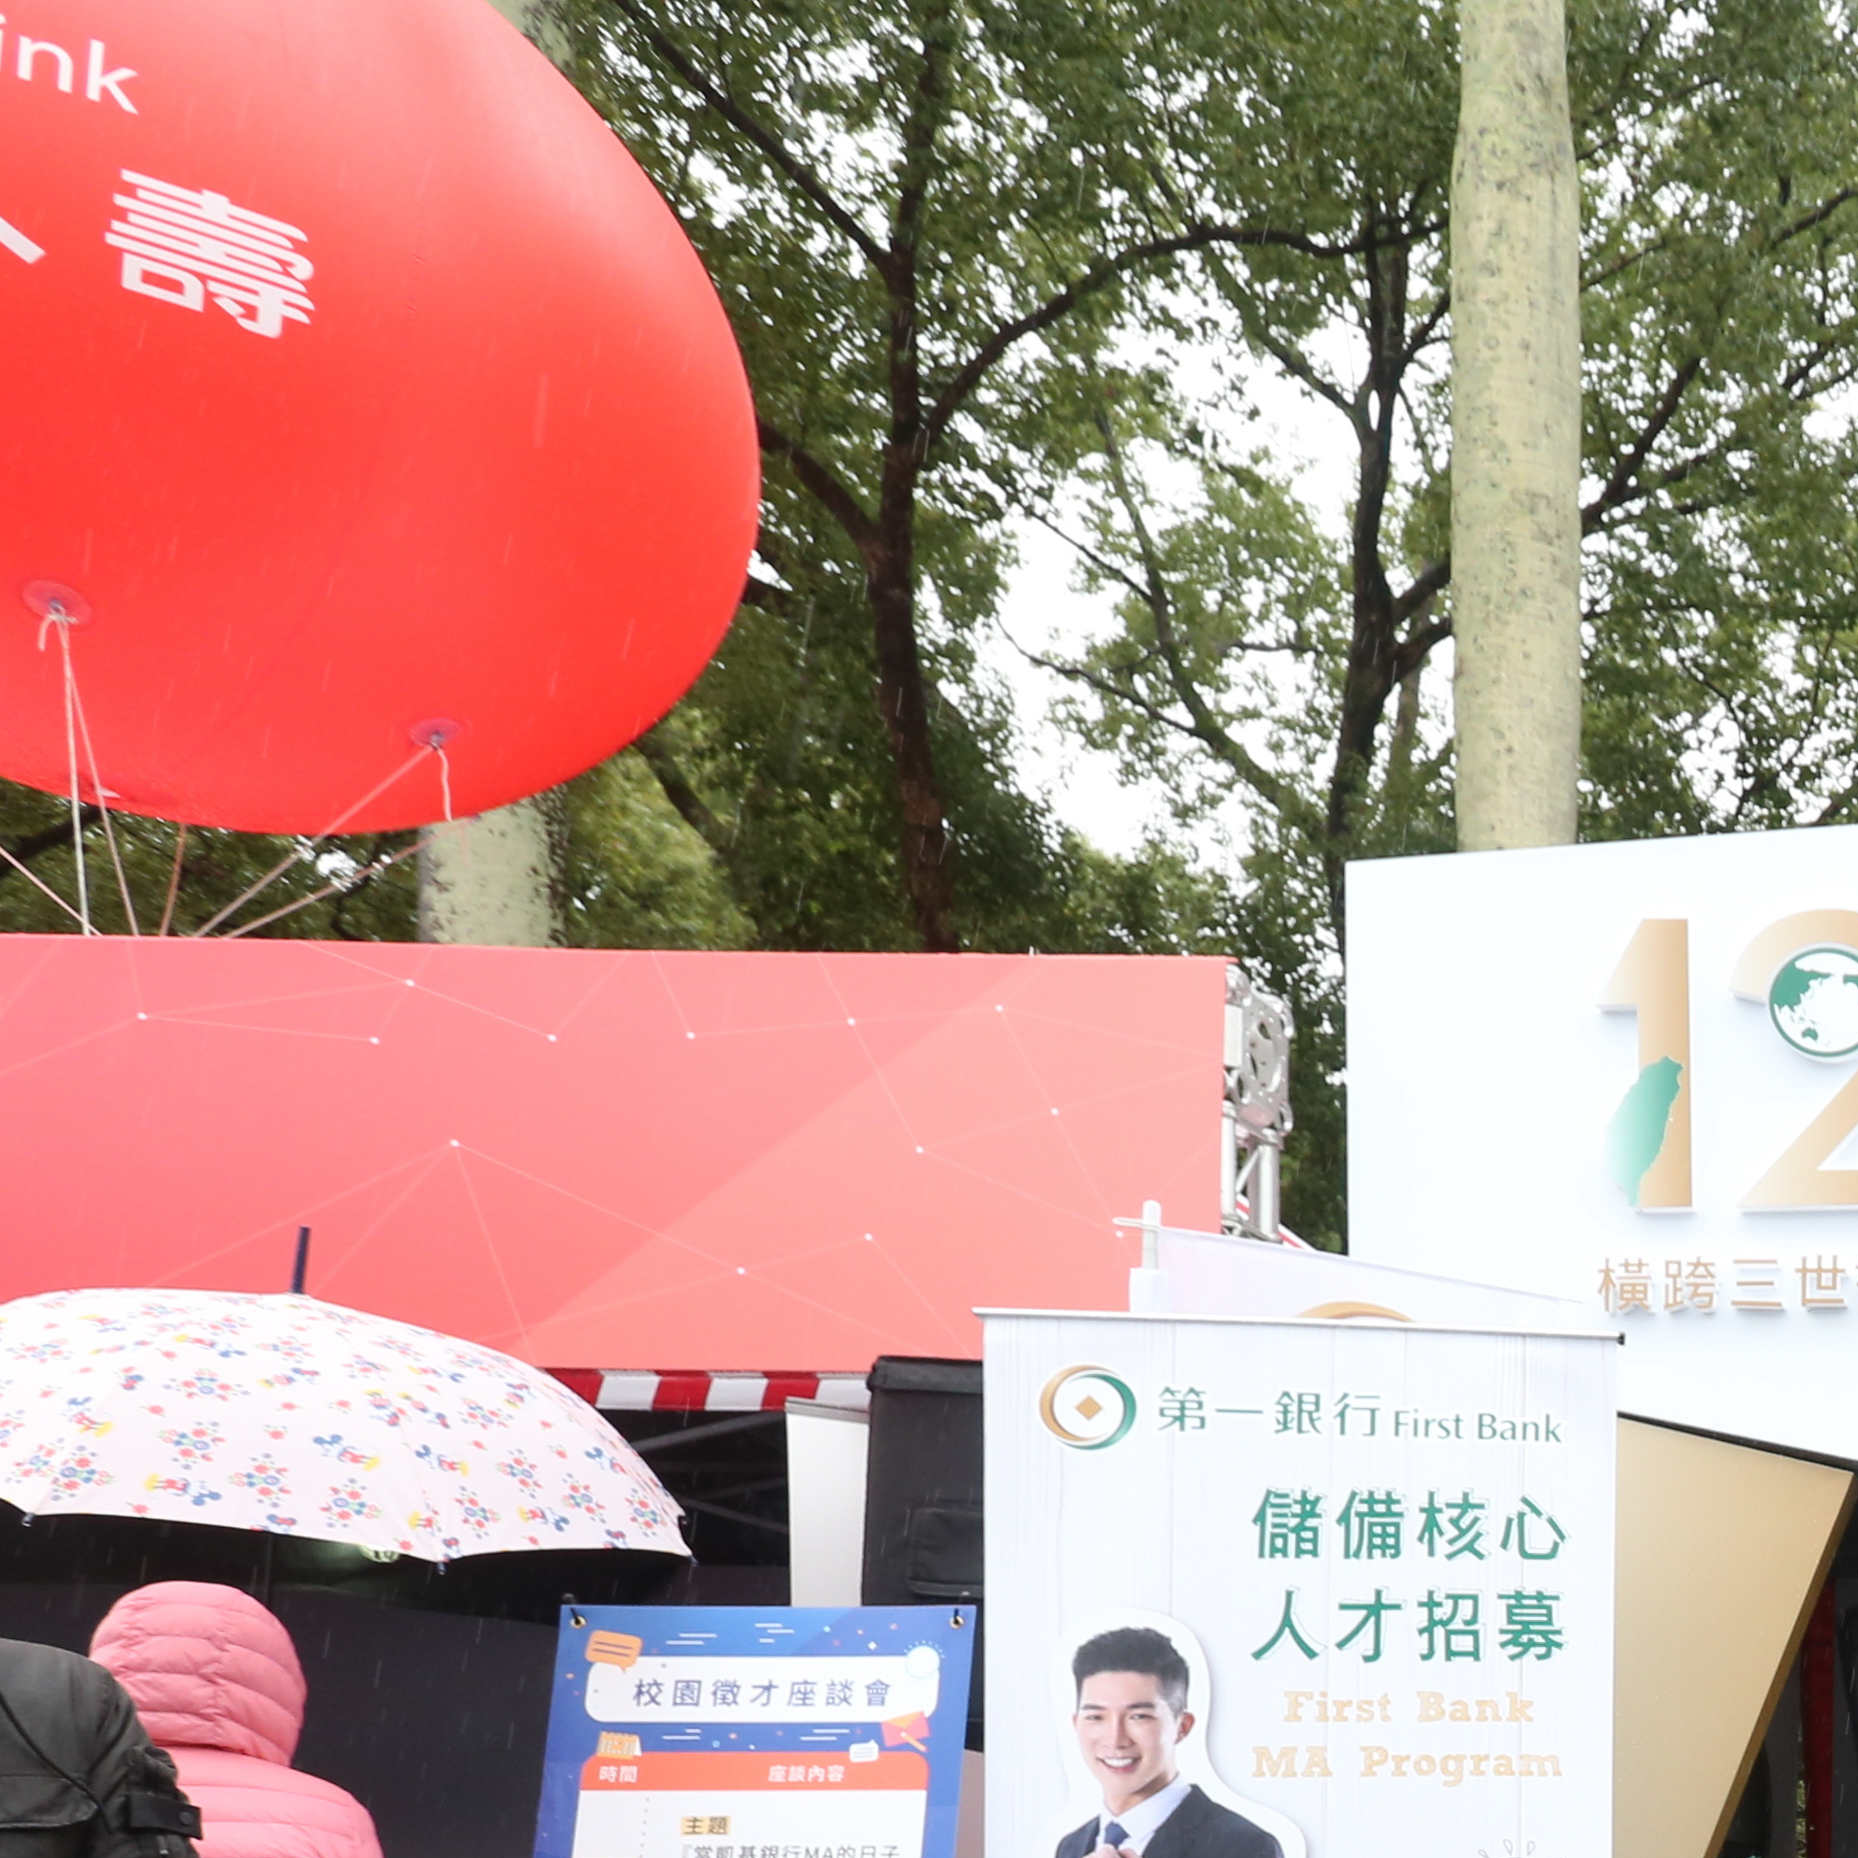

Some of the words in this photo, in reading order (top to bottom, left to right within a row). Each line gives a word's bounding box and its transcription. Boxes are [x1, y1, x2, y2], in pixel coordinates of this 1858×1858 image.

[1156, 1385, 1382, 1437] 第一銀行
[1392, 1408, 1465, 1440] First
[1476, 1411, 1563, 1444] Bank
[1251, 1487, 1568, 1562] 儲備核心
[1250, 1586, 1568, 1663] 人才招募
[632, 1677, 892, 1710] 校園徵才座談會
[1282, 1691, 1392, 1723] First
[1416, 1691, 1535, 1723] Bank
[598, 1765, 639, 1784] 時間
[1251, 1746, 1332, 1778] MA
[1359, 1746, 1563, 1788] Program
[682, 1816, 730, 1836] 主題
